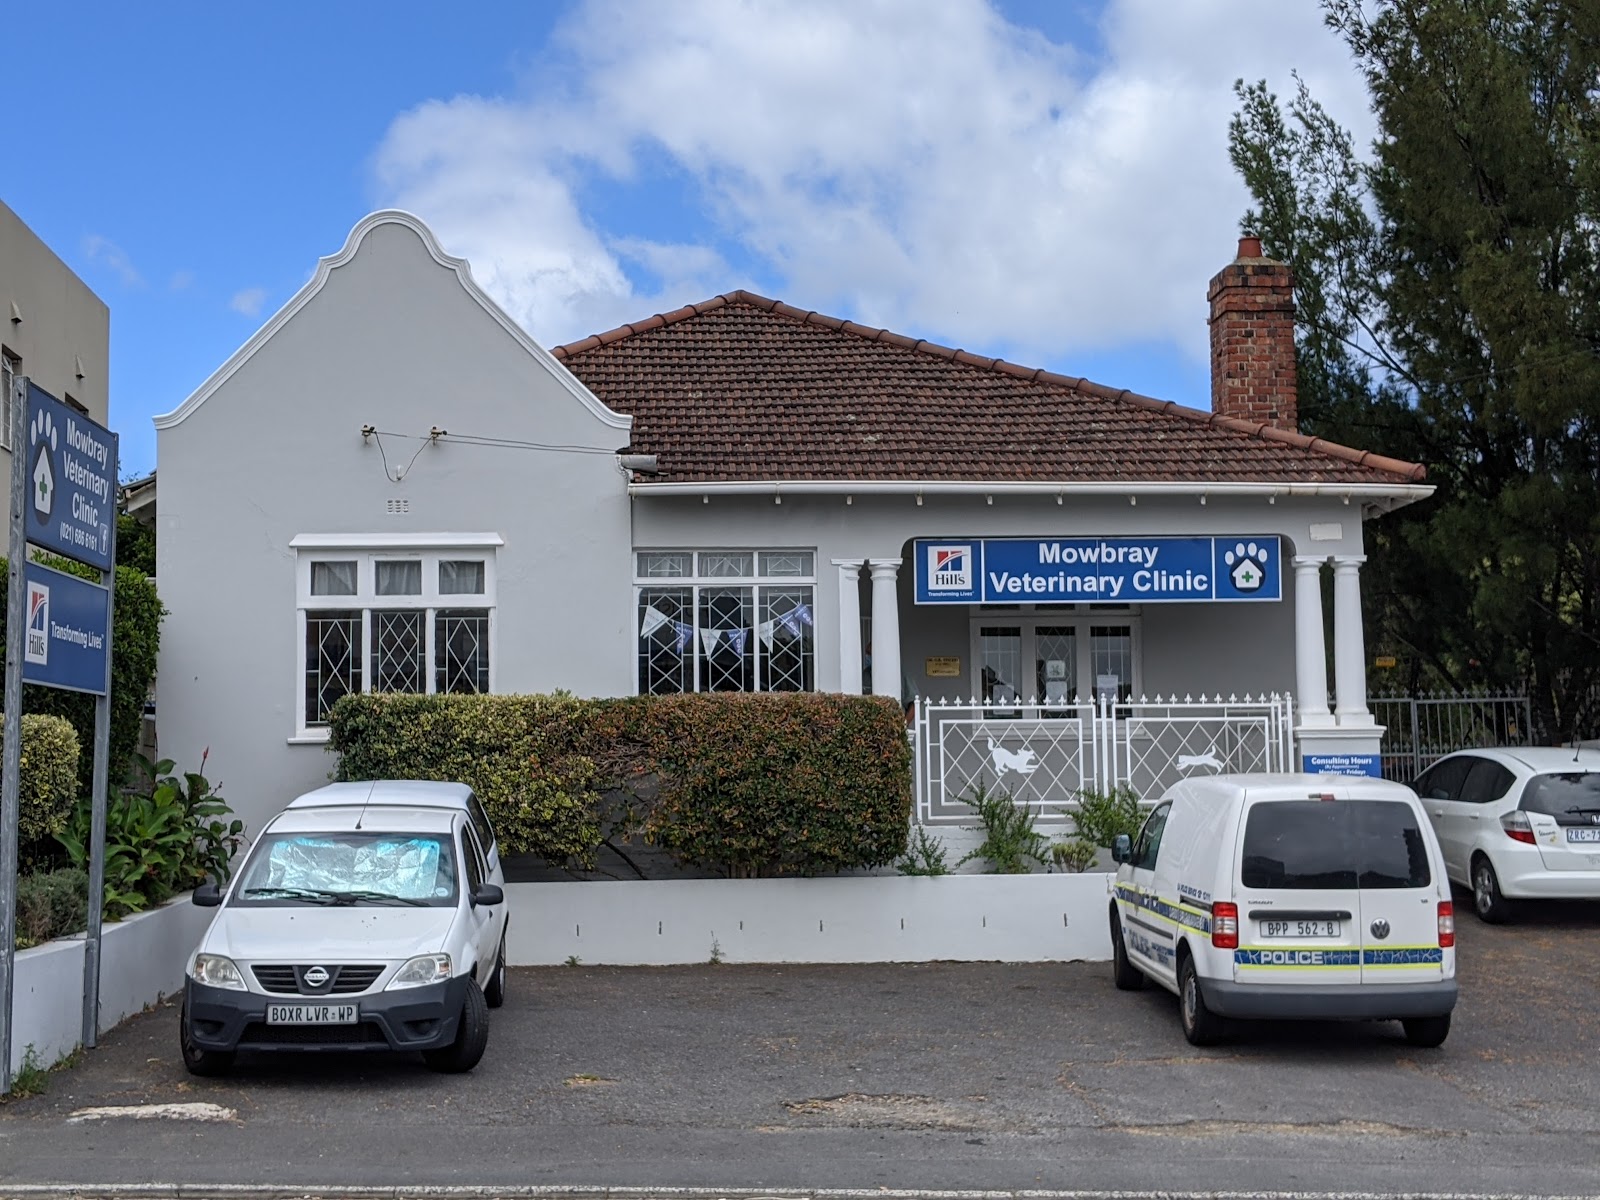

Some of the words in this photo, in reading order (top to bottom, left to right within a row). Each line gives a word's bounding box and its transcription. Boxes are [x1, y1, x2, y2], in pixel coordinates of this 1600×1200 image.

[66, 417, 108, 471] Mowbray
[63, 451, 109, 504] Veterinary
[72, 492, 98, 527] Clinic
[60, 521, 74, 546] (021)
[75, 528, 85, 546] 686
[1038, 542, 1158, 569] Mowbray
[935, 573, 966, 586] Hill's
[989, 571, 1124, 597] Veterinary
[1132, 569, 1209, 593] Clinic
[28, 633, 45, 657] Hill's
[51, 620, 87, 649] Transforming
[1267, 921, 1289, 936] BPP
[1297, 921, 1318, 935] 562
[1327, 921, 1334, 936] B
[1260, 950, 1324, 964] POLICE
[272, 1007, 303, 1021] BOXR
[306, 1007, 329, 1021] LVR
[338, 1006, 353, 1021] WP
